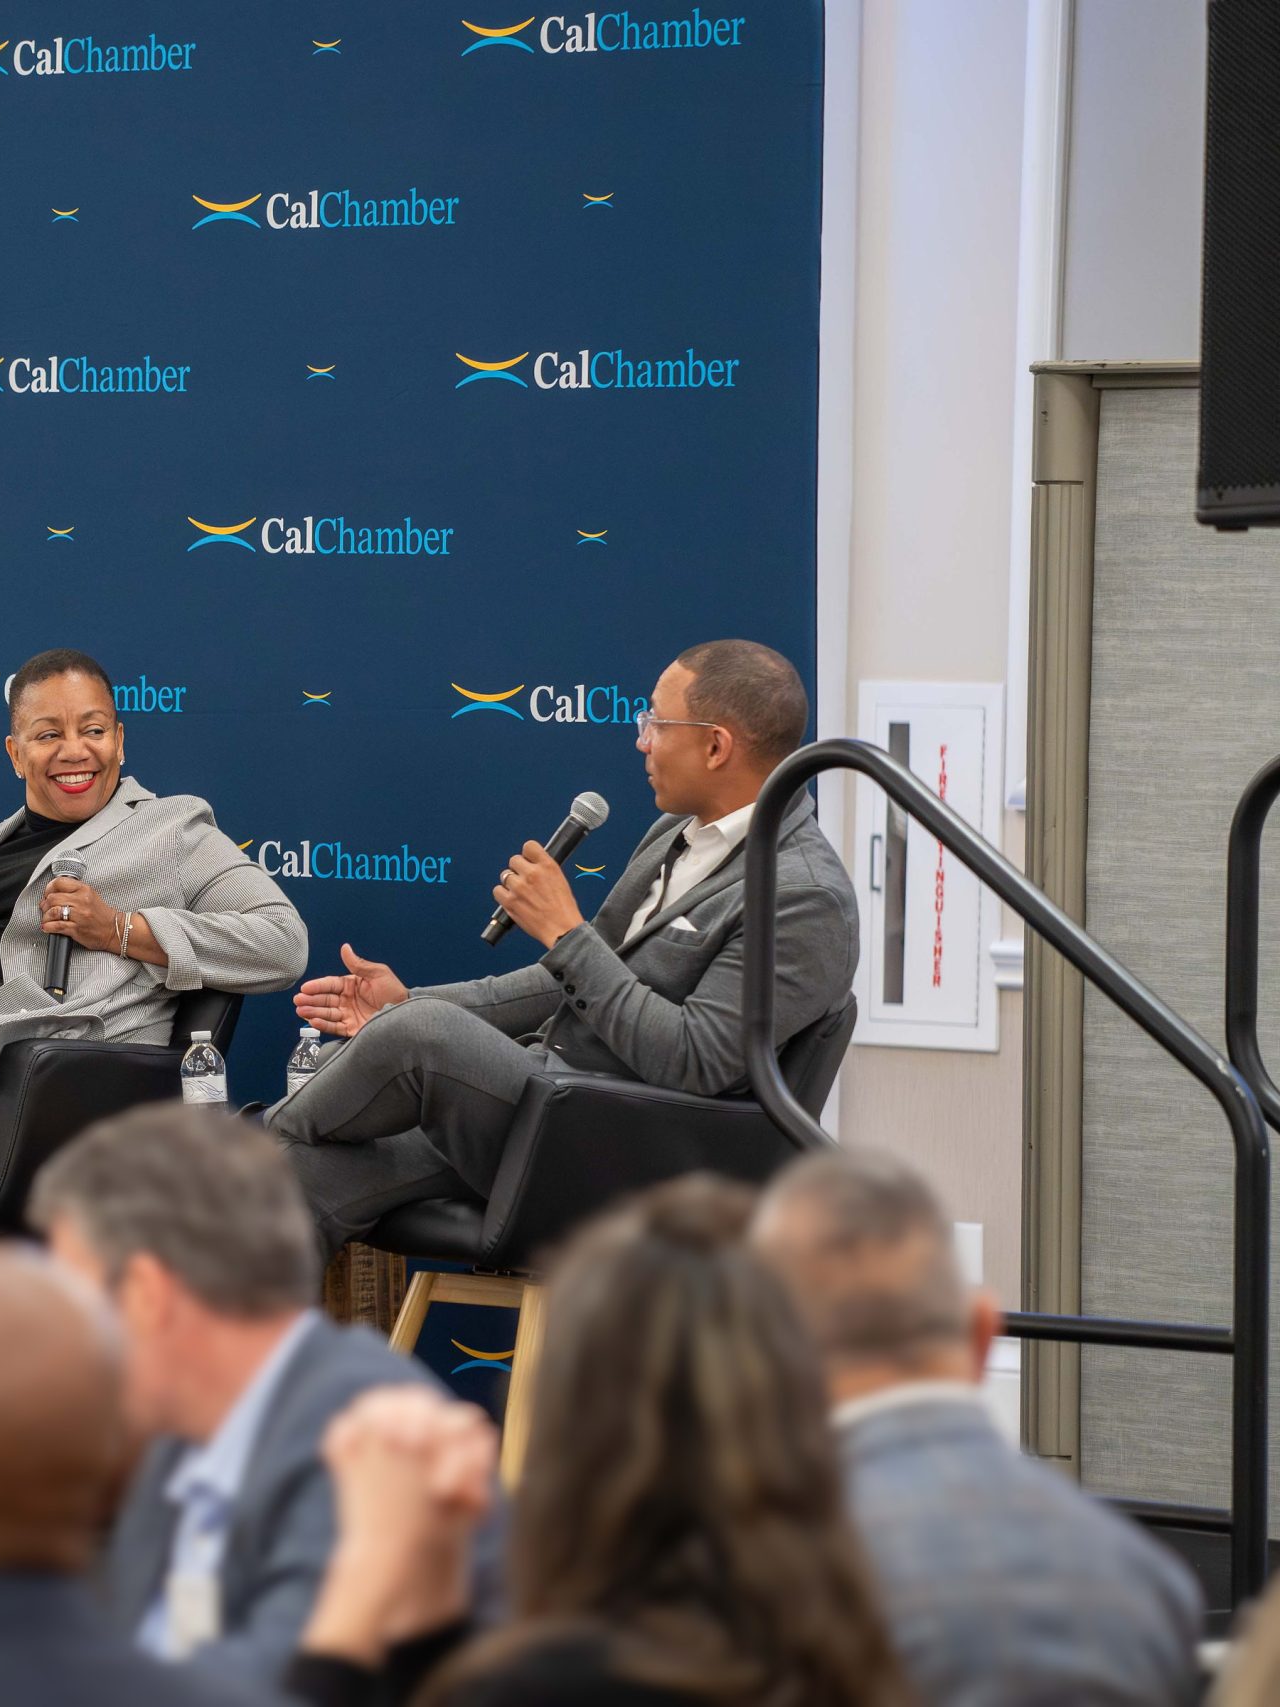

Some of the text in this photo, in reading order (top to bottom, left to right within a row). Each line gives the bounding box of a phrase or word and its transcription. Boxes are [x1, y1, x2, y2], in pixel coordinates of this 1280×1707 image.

[540, 8, 745, 54] CalChamber
[14, 34, 196, 76] CalChamber
[266, 188, 459, 229] CalChamber
[9, 356, 190, 393] CalChamber
[534, 349, 739, 389] CalChamber
[261, 516, 453, 555] CalChamber
[530, 684, 649, 724] CalCha
[258, 840, 451, 883] CalChamber
[932, 840, 945, 987] TINGUISHER
